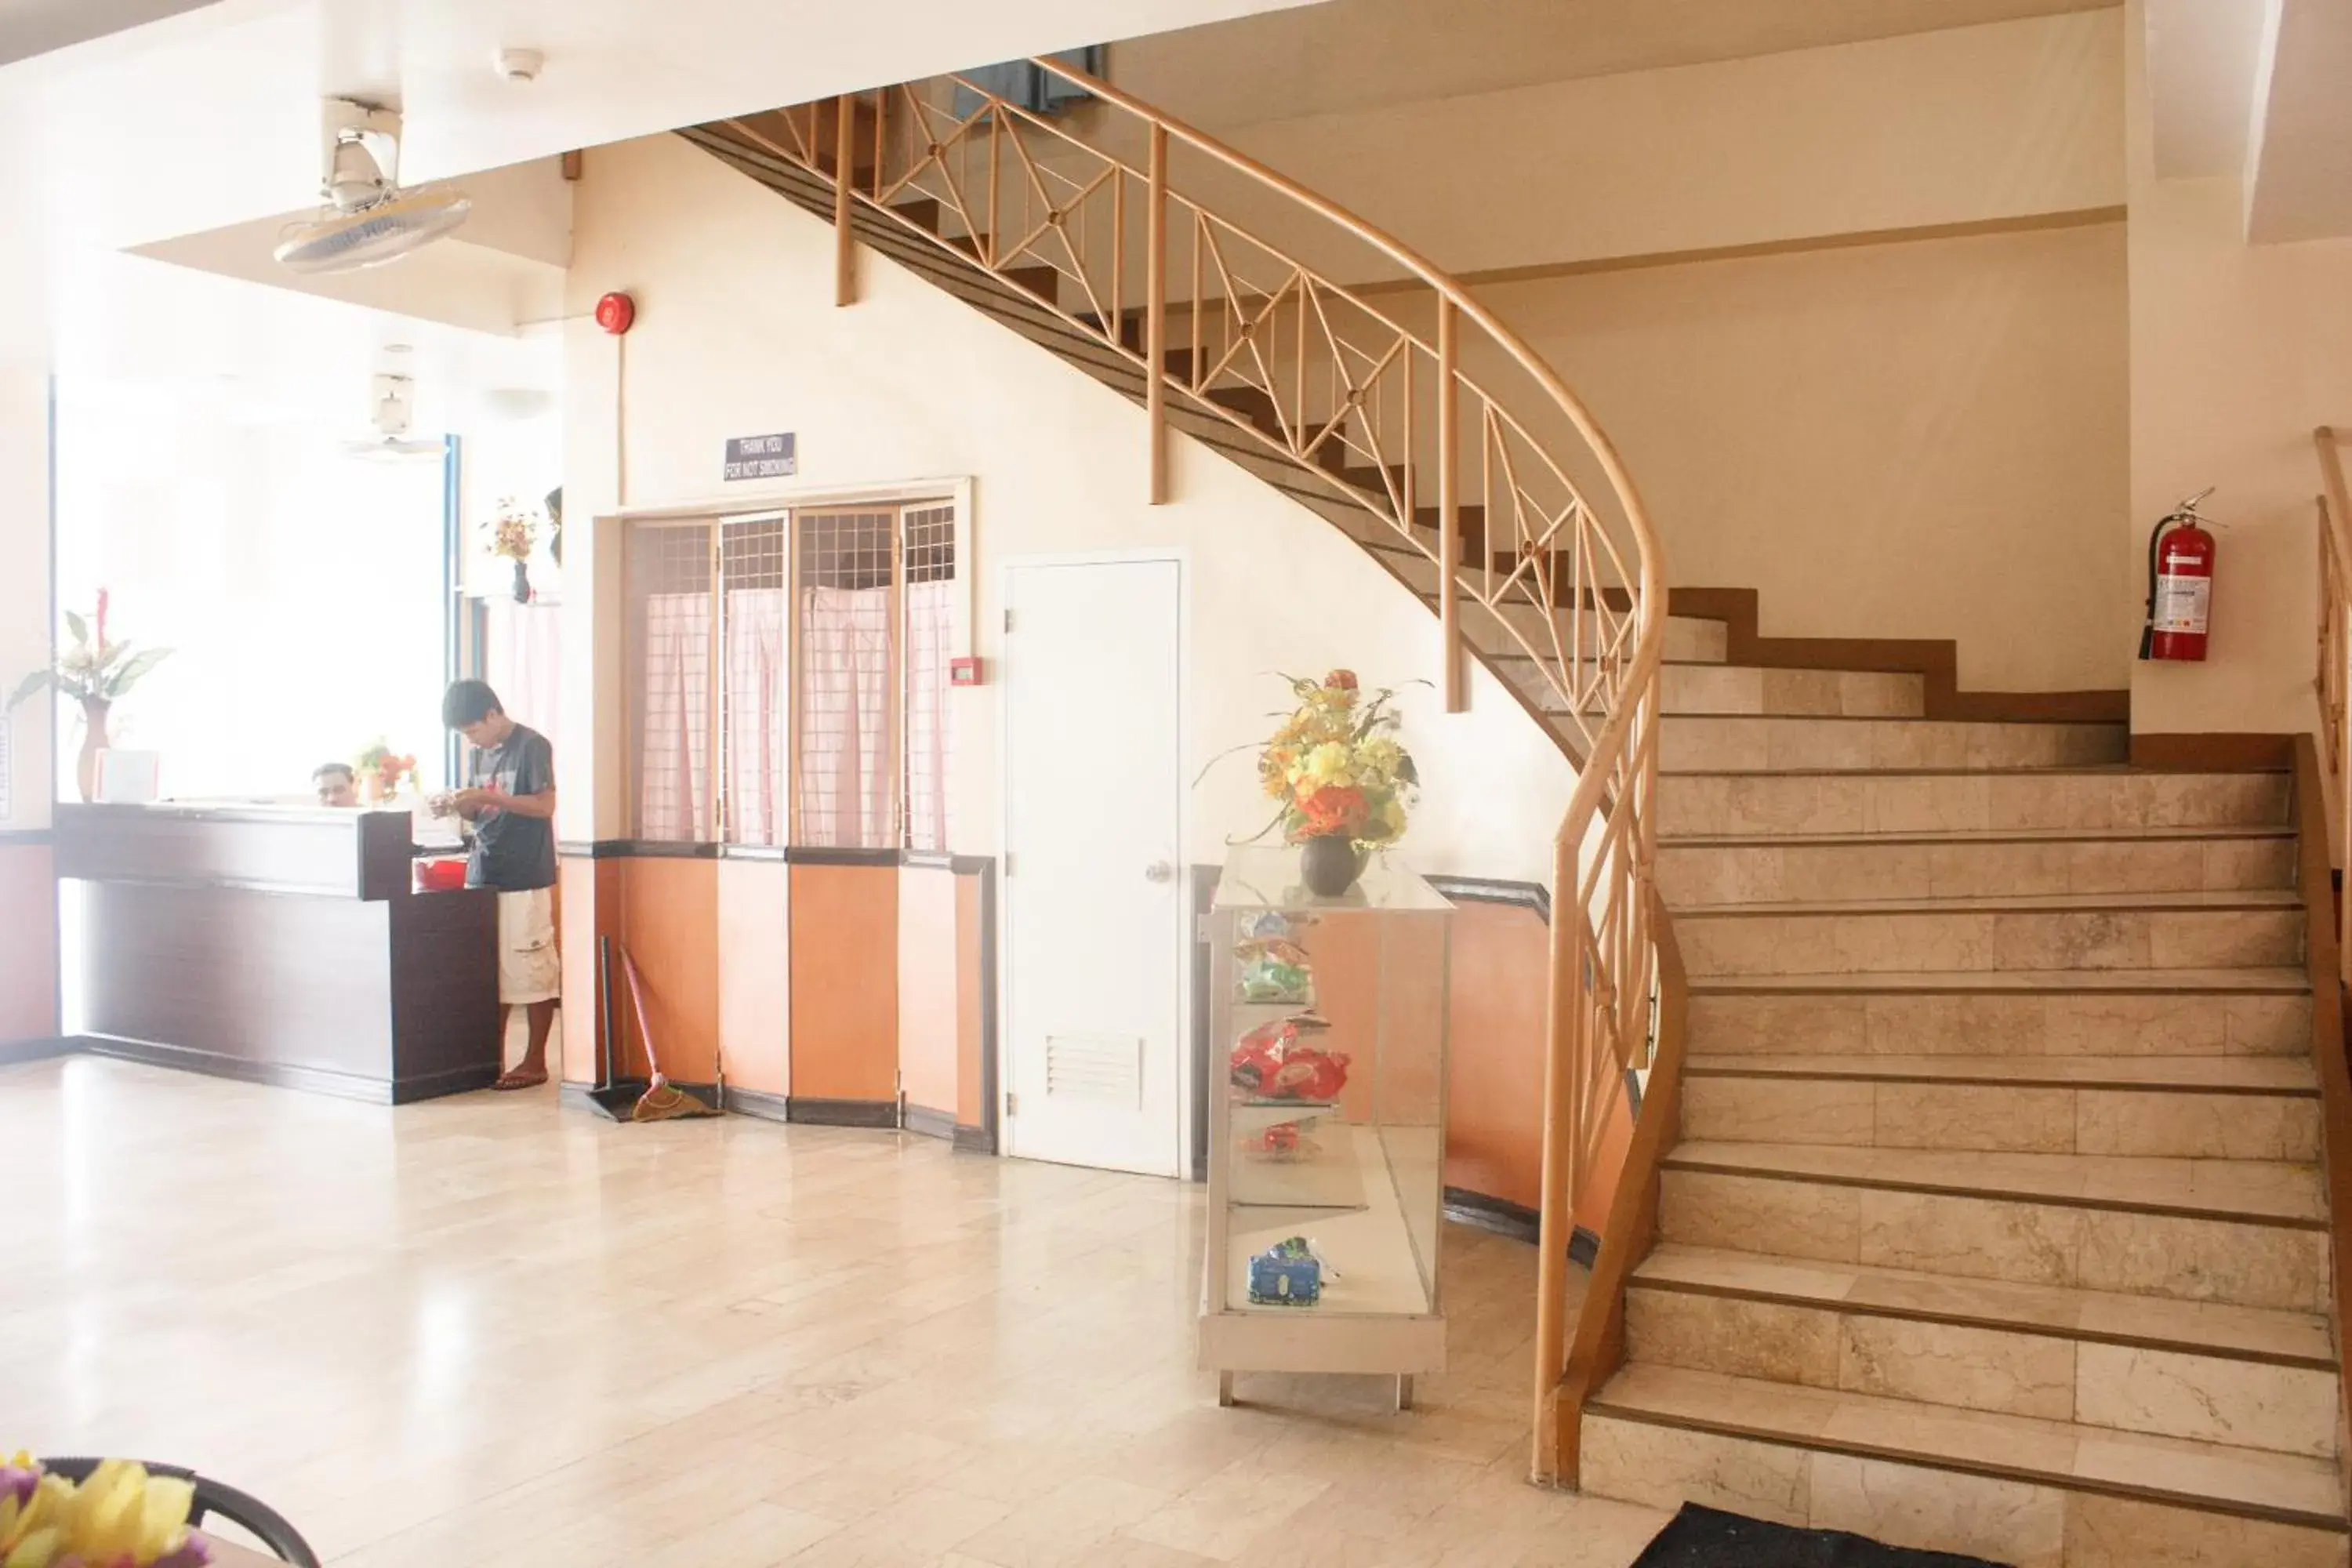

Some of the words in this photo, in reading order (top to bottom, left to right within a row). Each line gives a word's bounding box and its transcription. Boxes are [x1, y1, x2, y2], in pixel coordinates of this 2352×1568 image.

[740, 439, 765, 456] THANK
[766, 437, 782, 452] YOU
[727, 463, 741, 478] FOR
[742, 460, 758, 477] NOT
[759, 457, 794, 476] SMOKING
